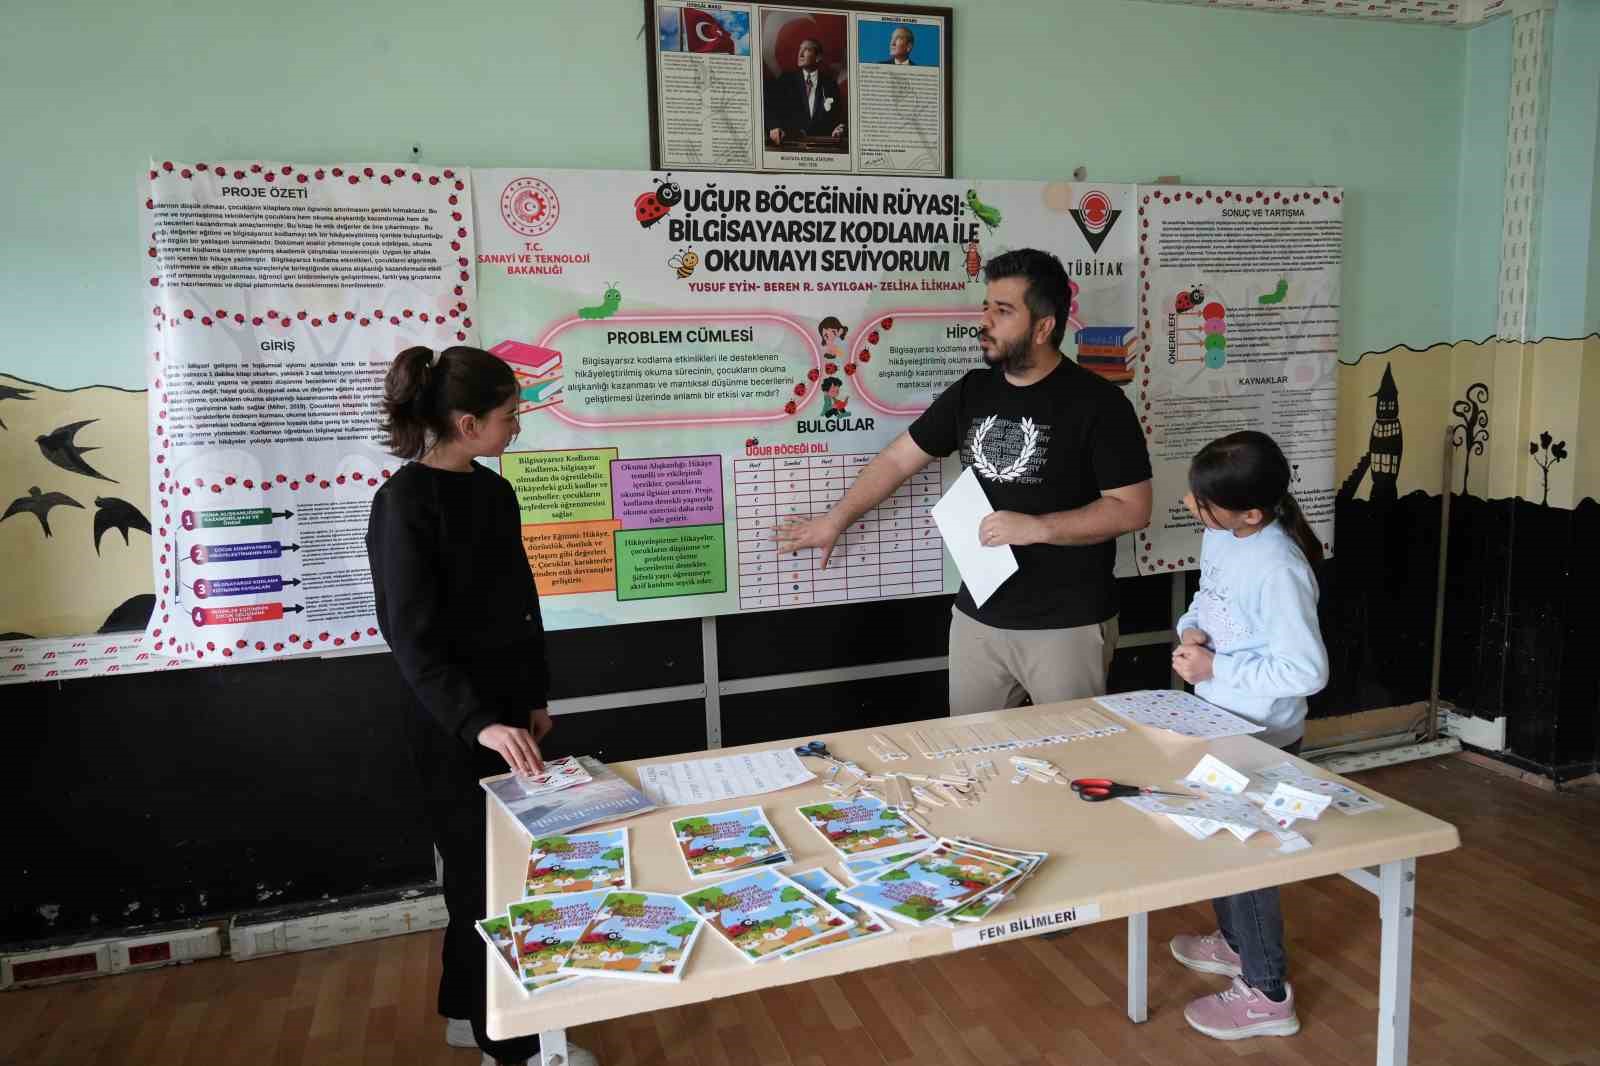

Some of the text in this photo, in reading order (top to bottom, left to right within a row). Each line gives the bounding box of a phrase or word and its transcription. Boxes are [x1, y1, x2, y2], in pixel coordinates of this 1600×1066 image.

[222, 186, 308, 199] PROJE ÖZETİ
[684, 183, 965, 216] UĞUR BÖCEĞİNİN RÜYASI:
[1222, 209, 1250, 218] SONUÇ
[1266, 210, 1305, 218] TARTIŞMA
[669, 213, 980, 244] BİLGİSAYARSIZ KODLAMA İLE
[525, 242, 544, 251] T.C.
[478, 254, 591, 263] SANAYİ VE TEKNOLOJİ
[705, 244, 950, 272] OKUMAYI SEVİYORUM
[508, 265, 563, 275] BAKANLIĞI
[1068, 262, 1123, 276] TÜBİTAK
[688, 282, 727, 292] YUSUF
[764, 282, 800, 292] BEREN
[804, 283, 814, 292] R.
[880, 278, 918, 291] ZELİHA
[922, 278, 965, 291] İLİKHAN
[608, 326, 753, 344] PROBLEM CÜMLESİ
[946, 324, 980, 338] HİPO
[260, 339, 296, 353] GİRİŞ
[890, 344, 966, 355] Bilgisayarsız kodlama
[582, 353, 779, 366] Bilgisayarsız kodlama etkinlikleri ile desteklenen
[644, 368, 673, 376] okuma
[676, 368, 714, 376] sürecinin,
[716, 366, 758, 376] çocukların
[760, 365, 786, 373] okuma
[568, 382, 609, 392] alışkanlığı
[612, 381, 656, 390] kazanması
[712, 378, 749, 388] düşünme
[750, 377, 794, 386] becerilerini
[1238, 376, 1288, 386] KAYNAKLAR
[636, 393, 671, 402] üzerinde
[704, 391, 714, 399] bir
[717, 390, 739, 399] etkisi
[756, 389, 780, 397] mıdır?
[798, 418, 875, 433] BULGULAR
[774, 442, 809, 455] BÖCEĞİ
[184, 514, 193, 526] 1
[195, 549, 202, 560] 2
[198, 584, 206, 595] 3
[195, 612, 202, 622] 4
[979, 907, 1077, 940] FEN BİLİMLERİ
